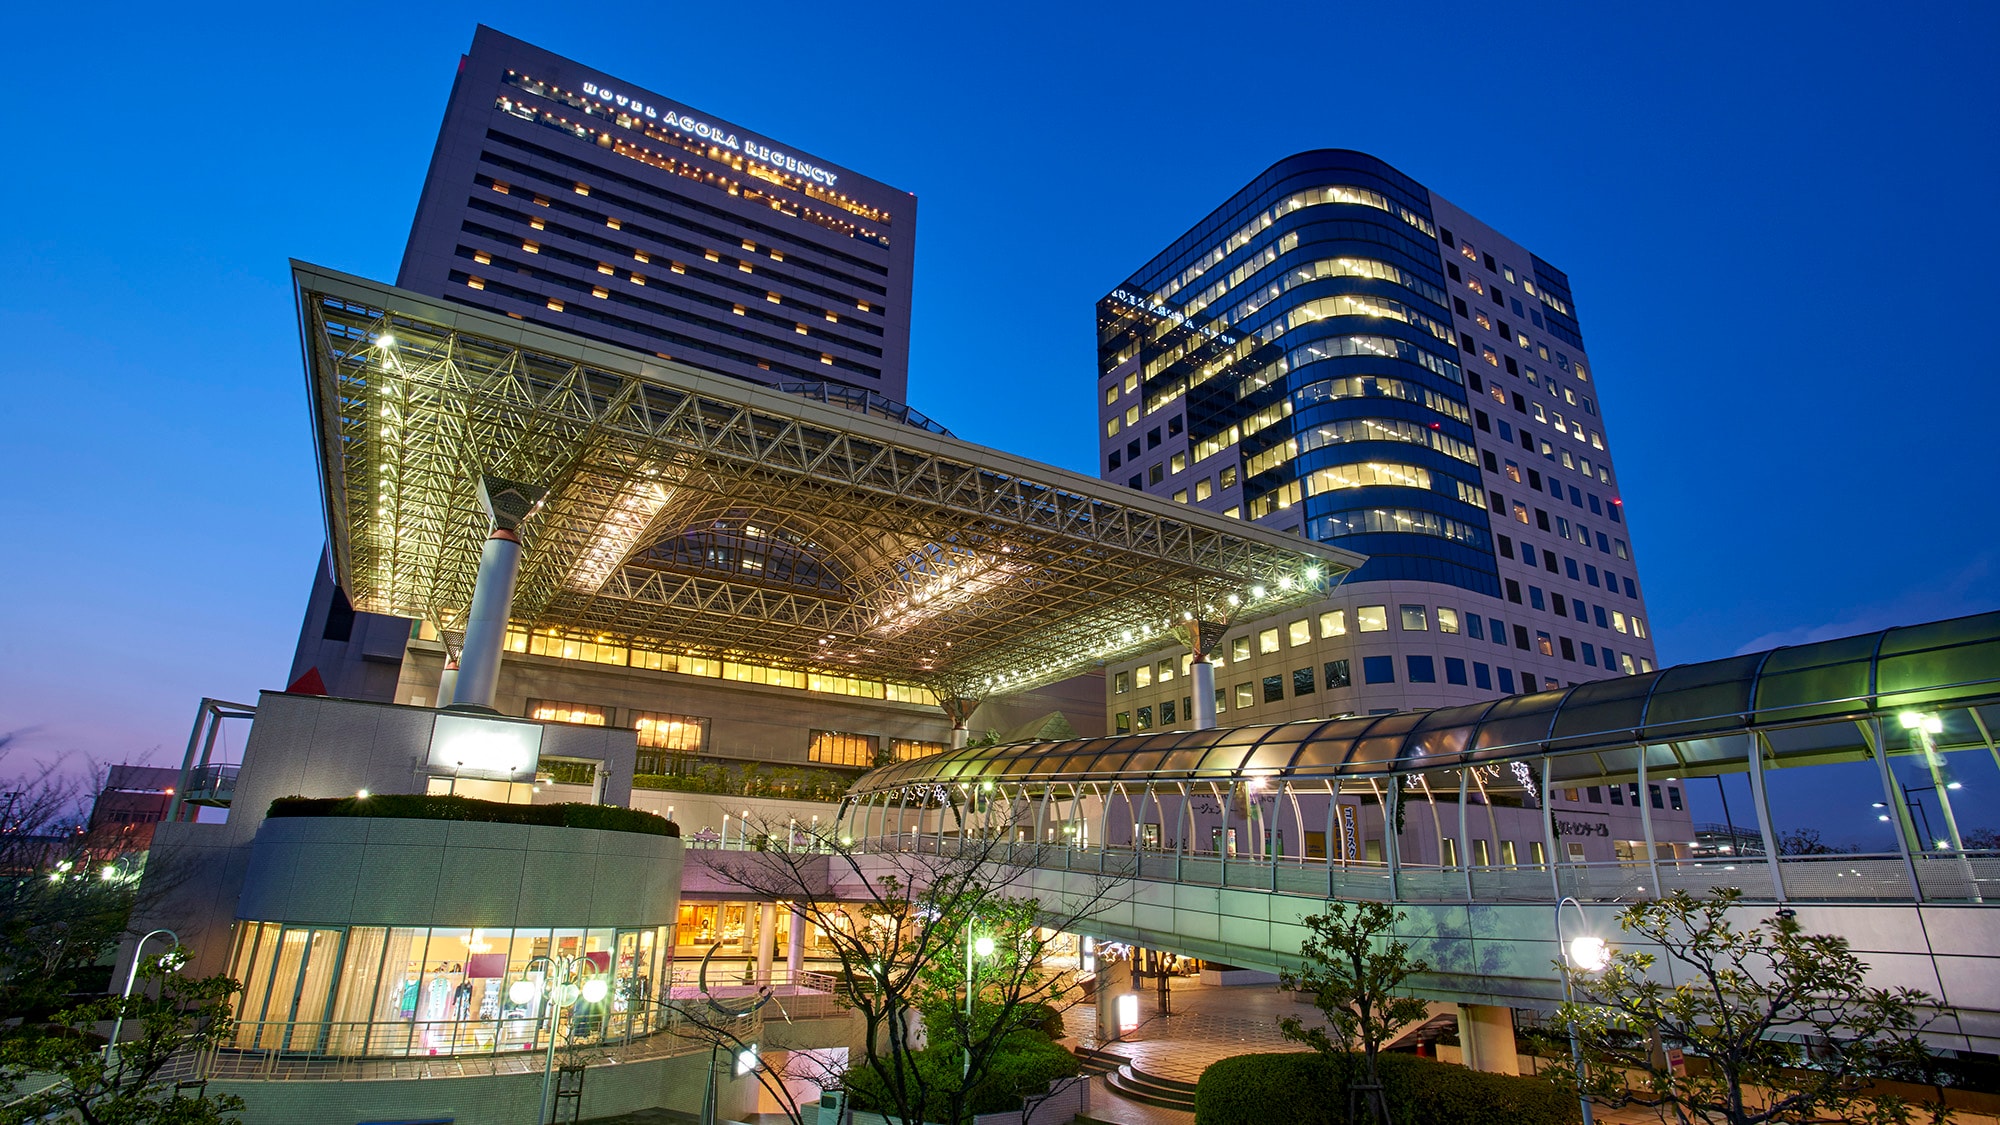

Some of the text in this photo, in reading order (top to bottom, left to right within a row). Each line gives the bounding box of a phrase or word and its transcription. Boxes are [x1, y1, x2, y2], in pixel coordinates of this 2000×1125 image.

[583, 82, 838, 186] HOTEL AGORA REGENCY
